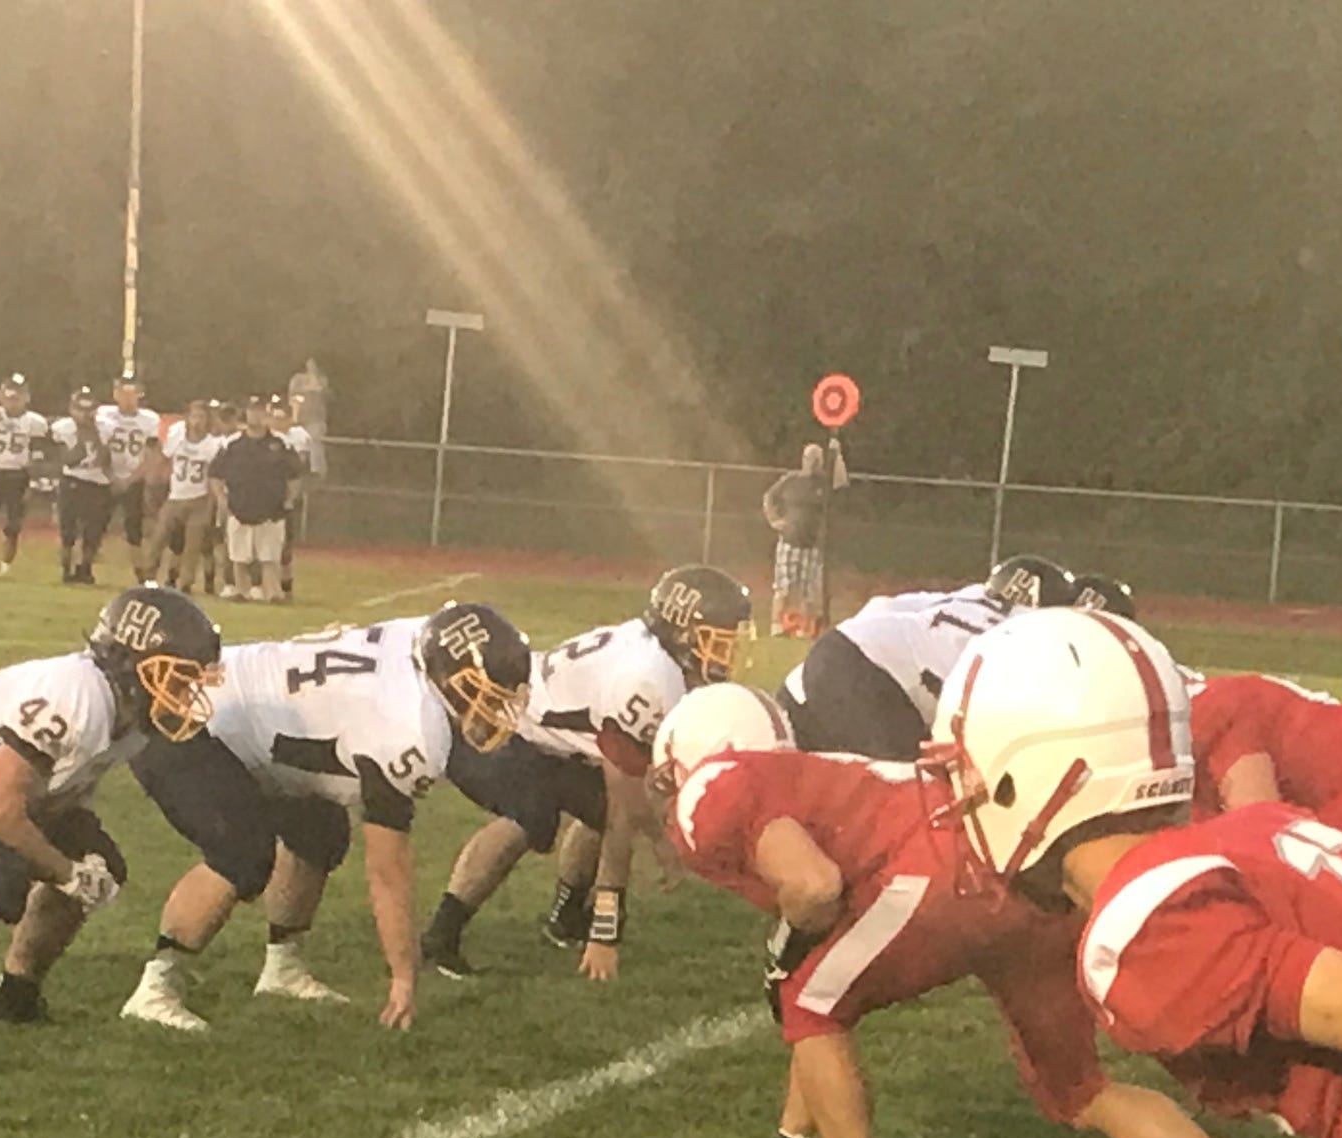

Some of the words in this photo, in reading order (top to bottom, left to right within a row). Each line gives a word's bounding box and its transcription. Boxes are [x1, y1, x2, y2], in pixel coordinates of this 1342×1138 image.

[109, 427, 144, 457] 56
[176, 456, 205, 483] 33
[115, 600, 161, 651] H
[660, 582, 700, 626] H
[439, 612, 490, 660] H
[19, 697, 68, 741] 42
